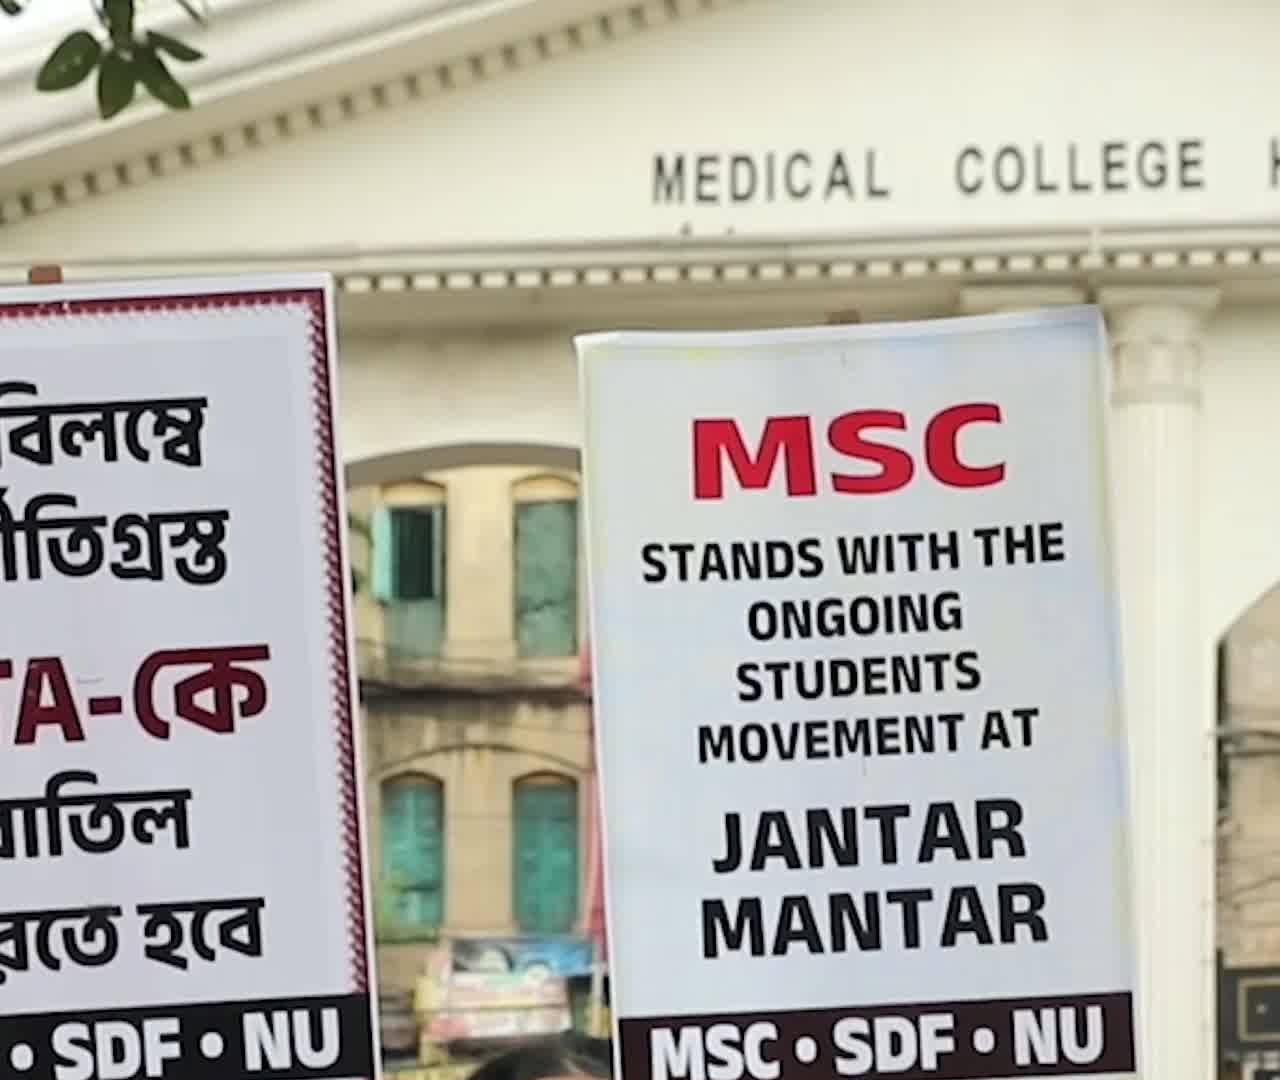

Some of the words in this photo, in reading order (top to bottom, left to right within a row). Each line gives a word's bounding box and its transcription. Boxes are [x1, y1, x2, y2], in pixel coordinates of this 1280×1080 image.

[652, 148, 891, 205] MEDICAL
[956, 139, 1204, 196] COLLEGE
[693, 403, 1005, 499] MSC
[642, 539, 823, 582] STANDS
[838, 531, 959, 575] WITH
[974, 523, 1064, 566] THE
[749, 592, 962, 640] ONGOING
[738, 651, 980, 701] STUDENTS
[699, 713, 964, 763] MOVEMENT
[981, 708, 1039, 749] AT
[713, 799, 1025, 873] JANTAR
[136, 897, 264, 970] হবে
[702, 883, 1048, 958] MANTAR
[241, 1006, 342, 1072] NU
[832, 1012, 957, 1077] SDF
[1012, 1004, 1105, 1067] NU
